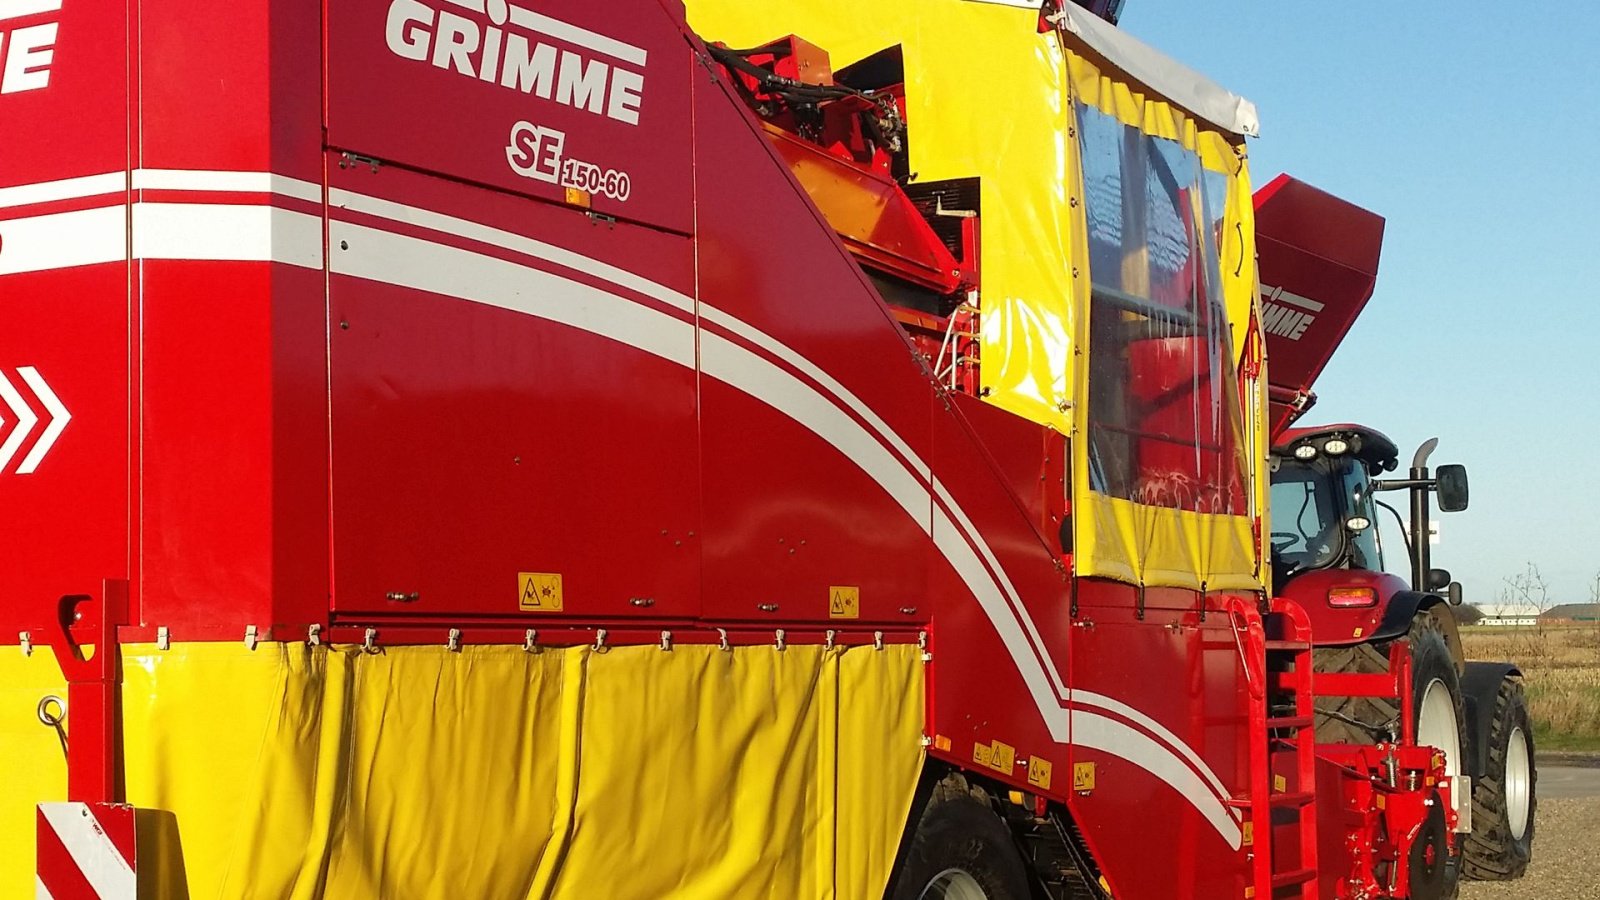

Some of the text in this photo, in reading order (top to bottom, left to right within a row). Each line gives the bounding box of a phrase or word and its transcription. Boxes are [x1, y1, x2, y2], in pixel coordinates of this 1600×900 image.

[0, 22, 59, 95] E
[385, 0, 645, 126] GRIMME
[505, 120, 630, 201] SE 150-60
